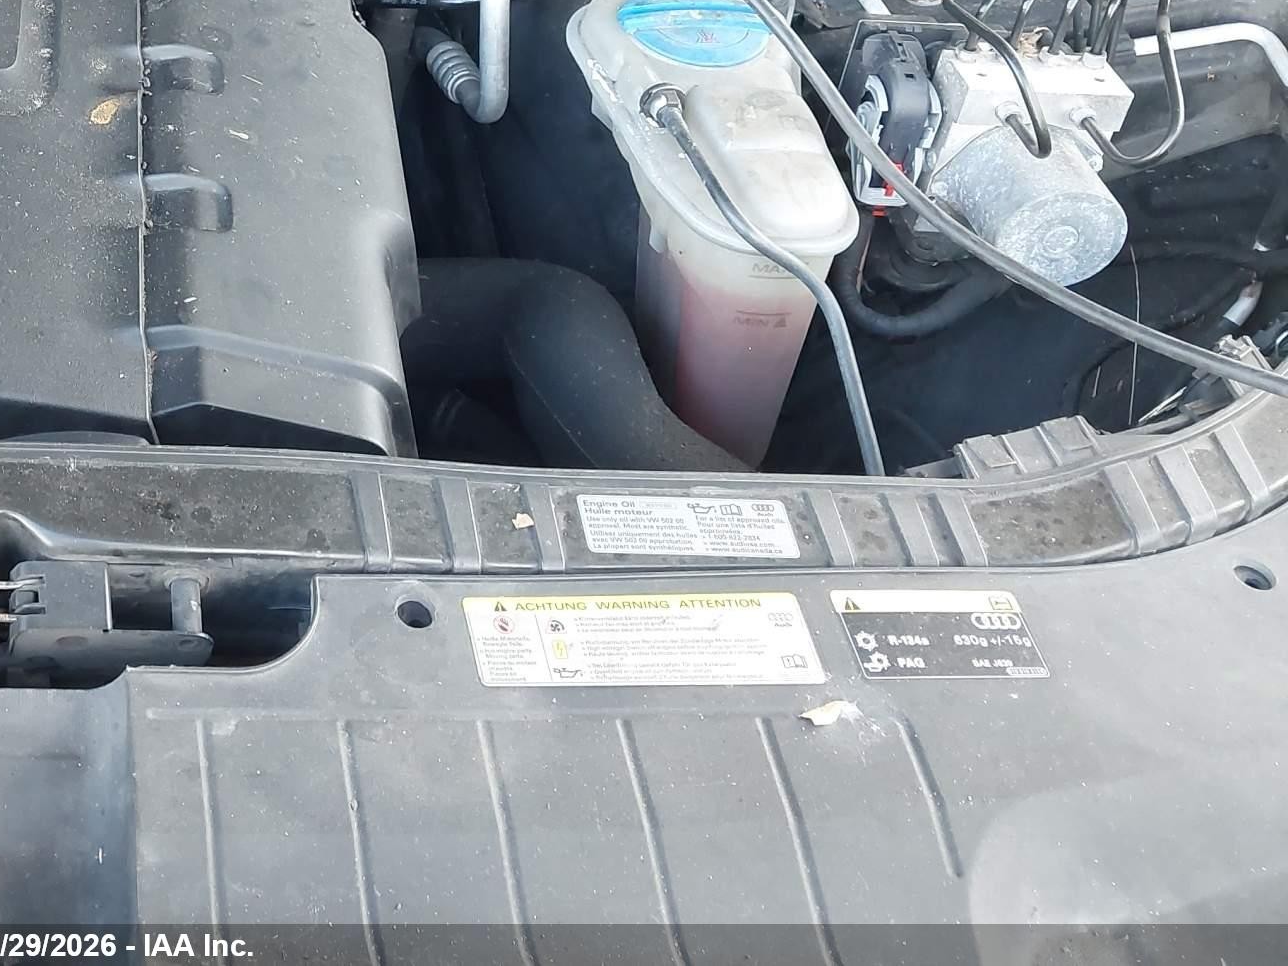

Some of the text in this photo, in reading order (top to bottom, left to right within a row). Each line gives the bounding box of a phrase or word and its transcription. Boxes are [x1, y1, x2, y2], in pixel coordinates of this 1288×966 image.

[752, 263, 786, 274] MA
[582, 499, 618, 509] Engine
[621, 500, 636, 508] Oil
[584, 507, 611, 515] Huile
[601, 516, 617, 524] only
[515, 598, 761, 611] ACHTUNG WARNING ATTENTION
[887, 634, 930, 646] R-134a
[896, 657, 926, 668] PAG
